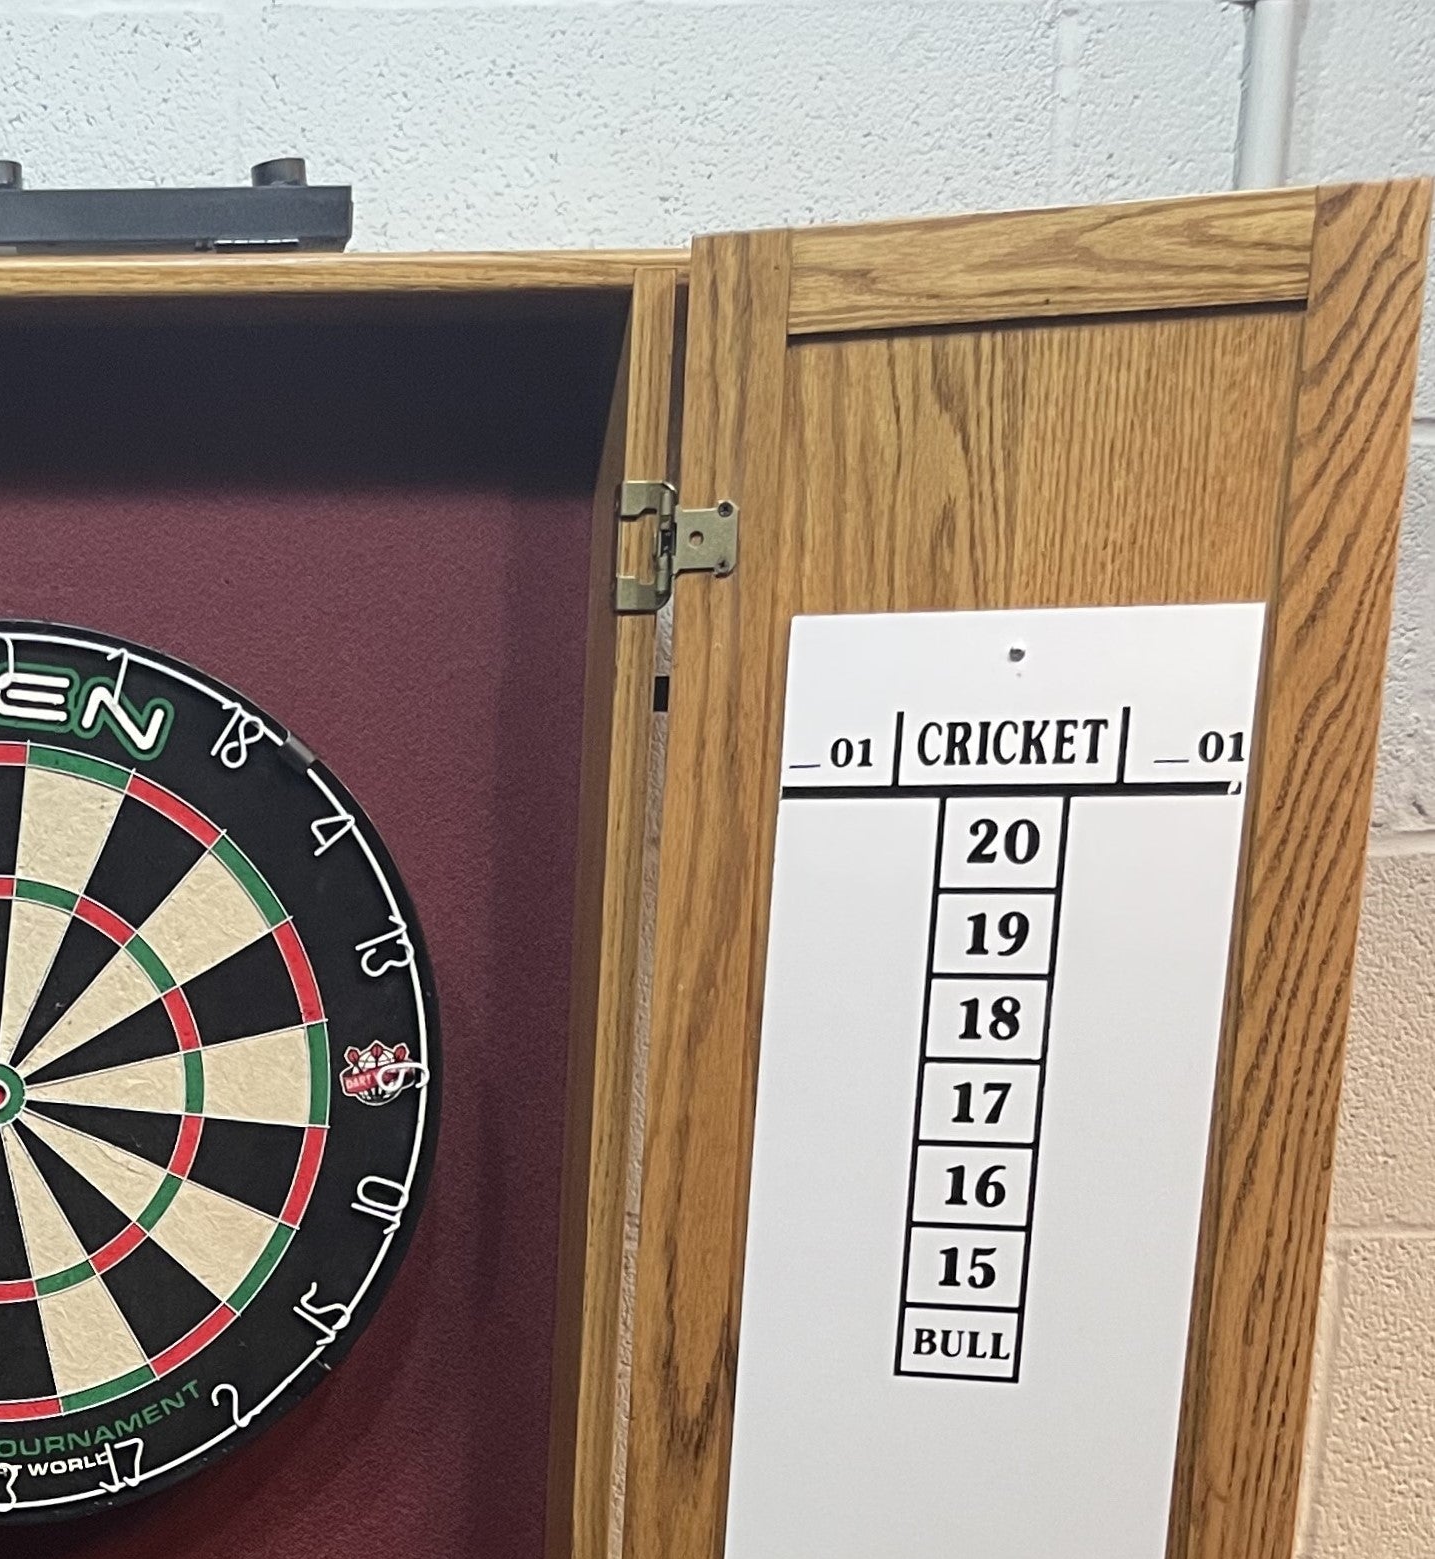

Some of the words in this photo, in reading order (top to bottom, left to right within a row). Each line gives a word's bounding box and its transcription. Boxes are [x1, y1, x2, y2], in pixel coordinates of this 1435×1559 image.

[211, 703, 264, 769] 18
[917, 718, 1109, 766] CRICKET
[311, 815, 355, 857] 4
[966, 818, 1040, 865] 20
[355, 915, 414, 977] 13
[965, 911, 1030, 957] 19
[958, 996, 1021, 1041] 18
[951, 1081, 1012, 1124] 17
[351, 1175, 409, 1234] 10
[944, 1164, 1007, 1208] 16
[938, 1246, 997, 1289] 15
[293, 1282, 351, 1346] 15
[912, 1328, 1010, 1360] BULL
[211, 1383, 258, 1427] 2
[99, 1438, 144, 1493] 17
